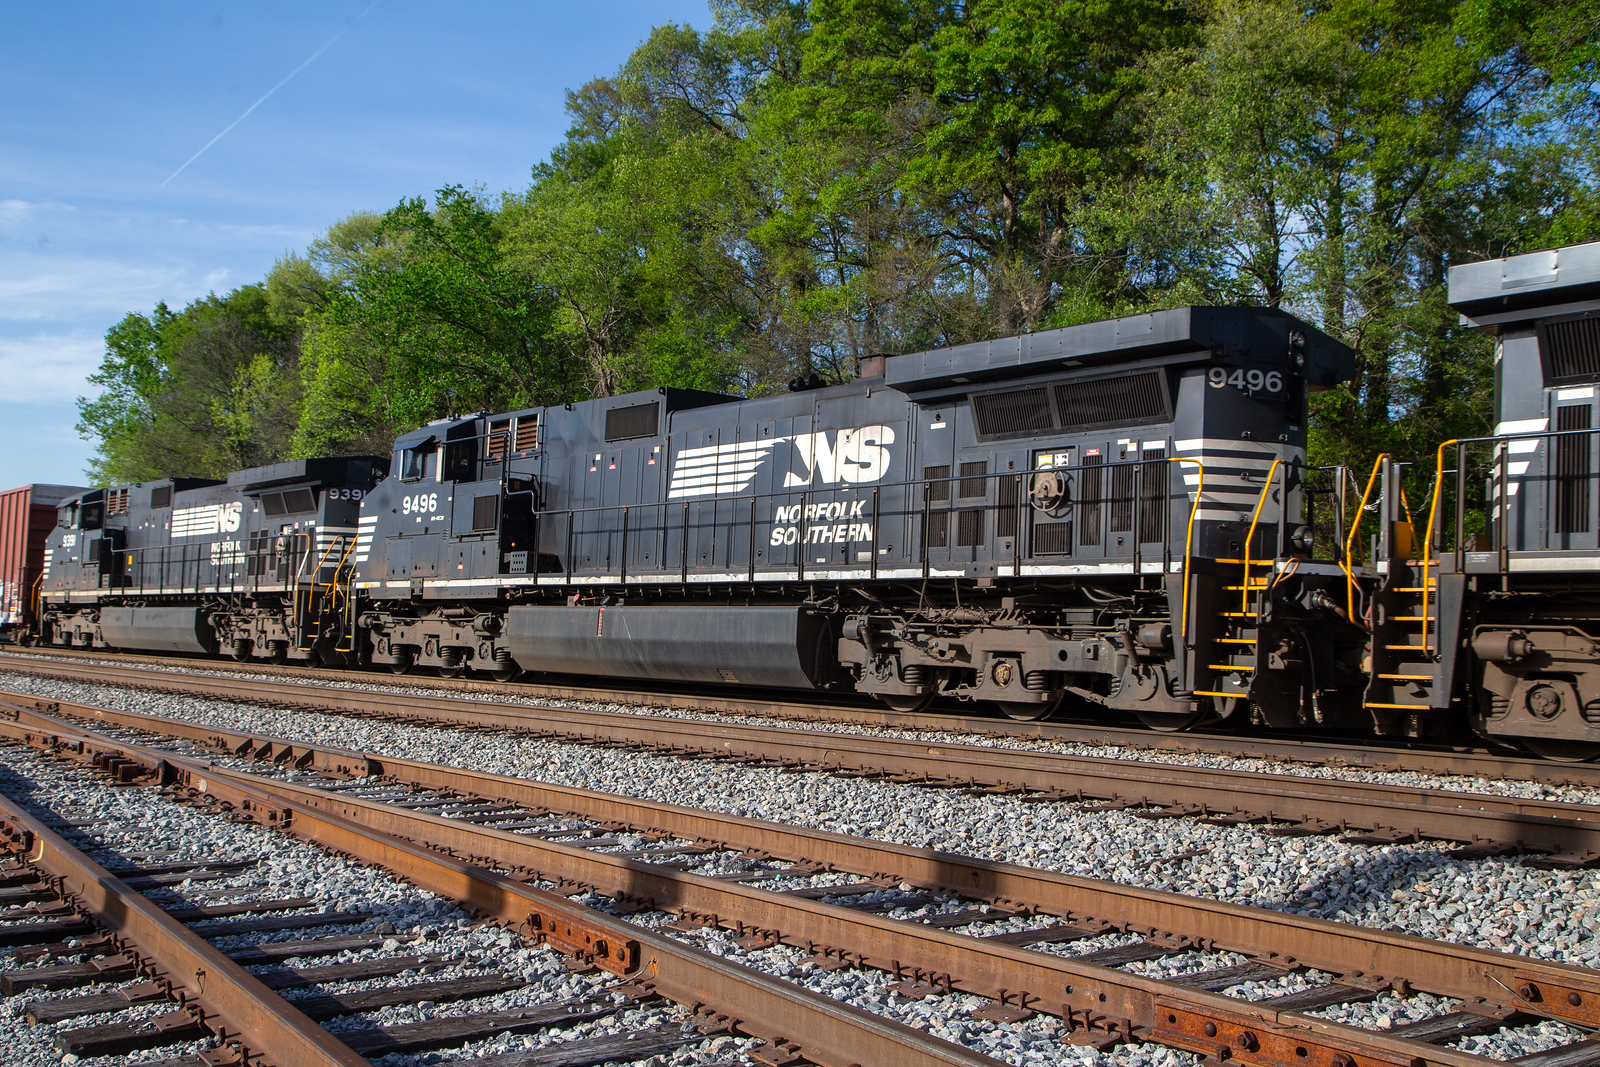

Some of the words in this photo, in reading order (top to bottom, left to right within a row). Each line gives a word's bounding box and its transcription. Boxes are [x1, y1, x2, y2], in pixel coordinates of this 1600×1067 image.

[1208, 366, 1283, 393] 9496
[783, 425, 896, 488] NS
[402, 492, 438, 515] 9496
[775, 499, 867, 524] NORFOLK
[770, 522, 874, 546] SOUTHERN
